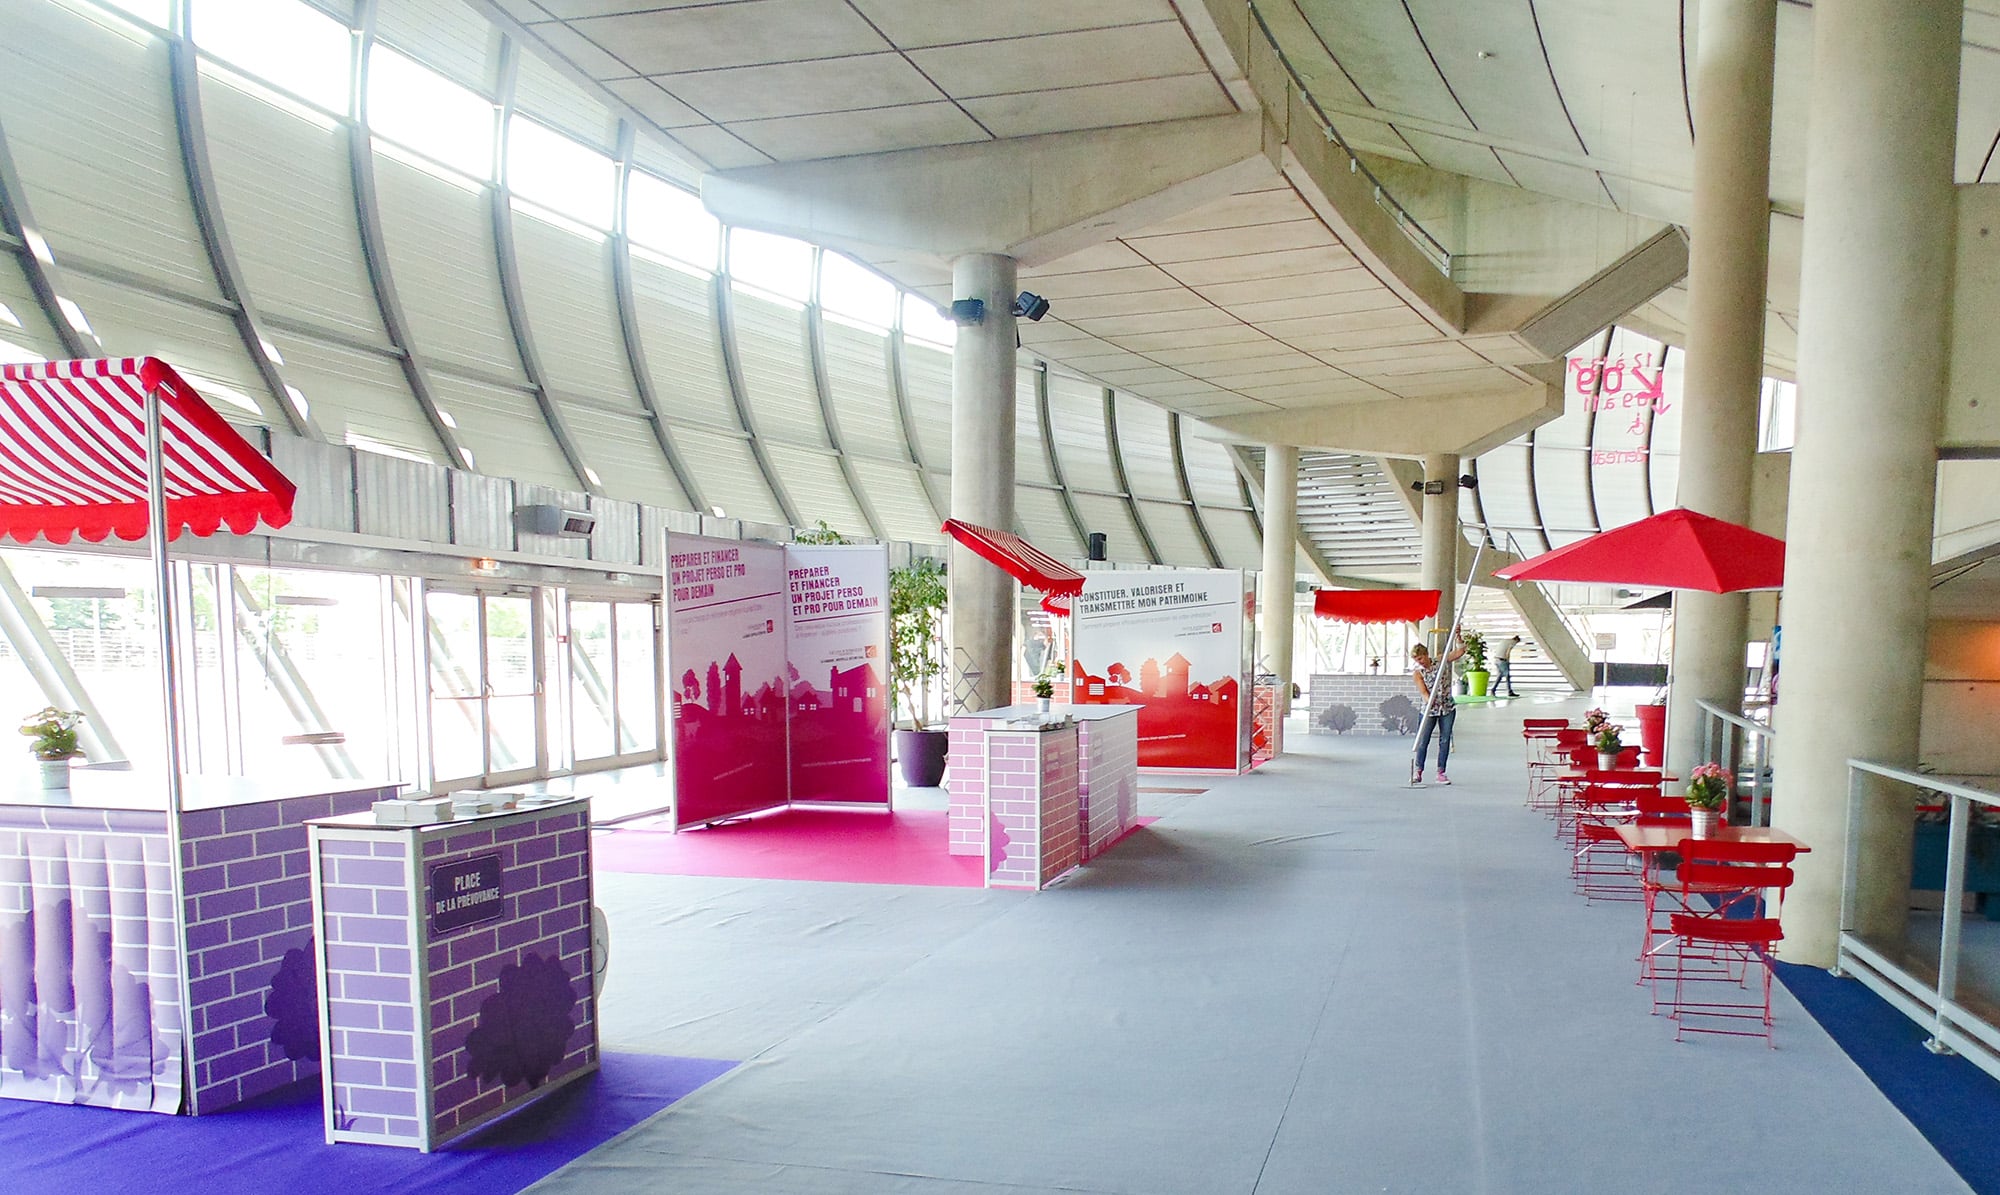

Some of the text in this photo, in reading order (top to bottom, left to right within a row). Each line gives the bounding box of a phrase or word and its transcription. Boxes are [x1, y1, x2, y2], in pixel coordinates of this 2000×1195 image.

[671, 548, 739, 569] PRÉPARER ET FINANCER
[672, 564, 746, 586] UN PROJET PERSO ET PRO
[789, 566, 830, 580] PRÉPARER
[673, 584, 714, 602] POUR DEMAIN
[790, 577, 840, 592] ET FINANCER
[1131, 584, 1173, 597] VALORISER
[1175, 582, 1185, 593] ET
[792, 586, 863, 604] UN PROJET PERSO
[1079, 592, 1208, 614] TRANSMETTRE MON PATRIMOINE
[793, 597, 878, 616] ET PRO POUR DEMAIN
[455, 872, 480, 890] PLACE
[436, 888, 499, 914] DE LA PRÉVOYANCE
